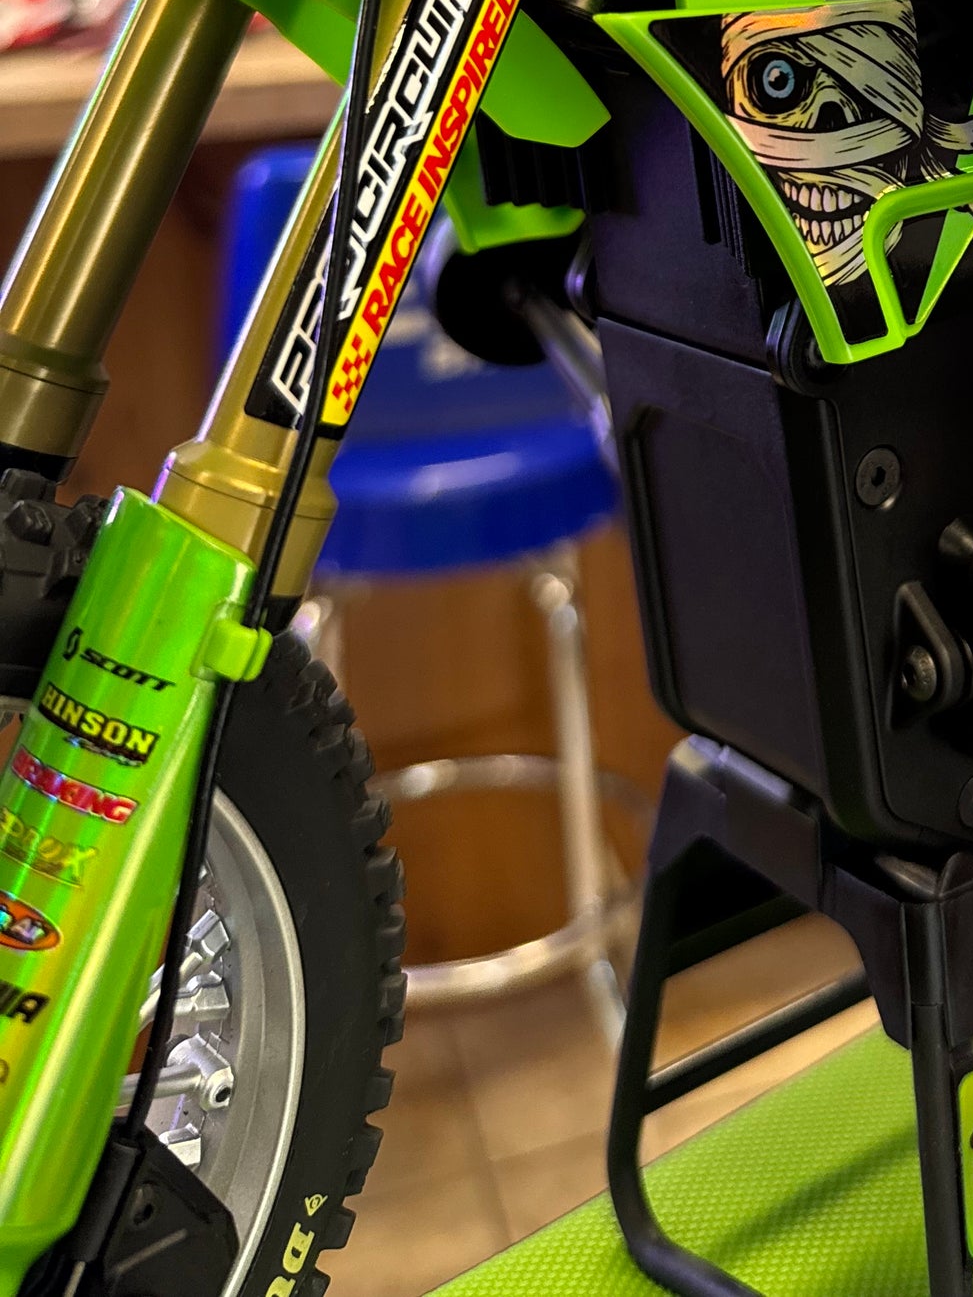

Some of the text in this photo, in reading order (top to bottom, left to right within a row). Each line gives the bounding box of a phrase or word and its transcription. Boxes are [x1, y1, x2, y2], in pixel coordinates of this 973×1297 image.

[361, 192, 429, 340] RACE
[80, 647, 176, 692] SCOTT
[41, 685, 156, 756] HINSON
